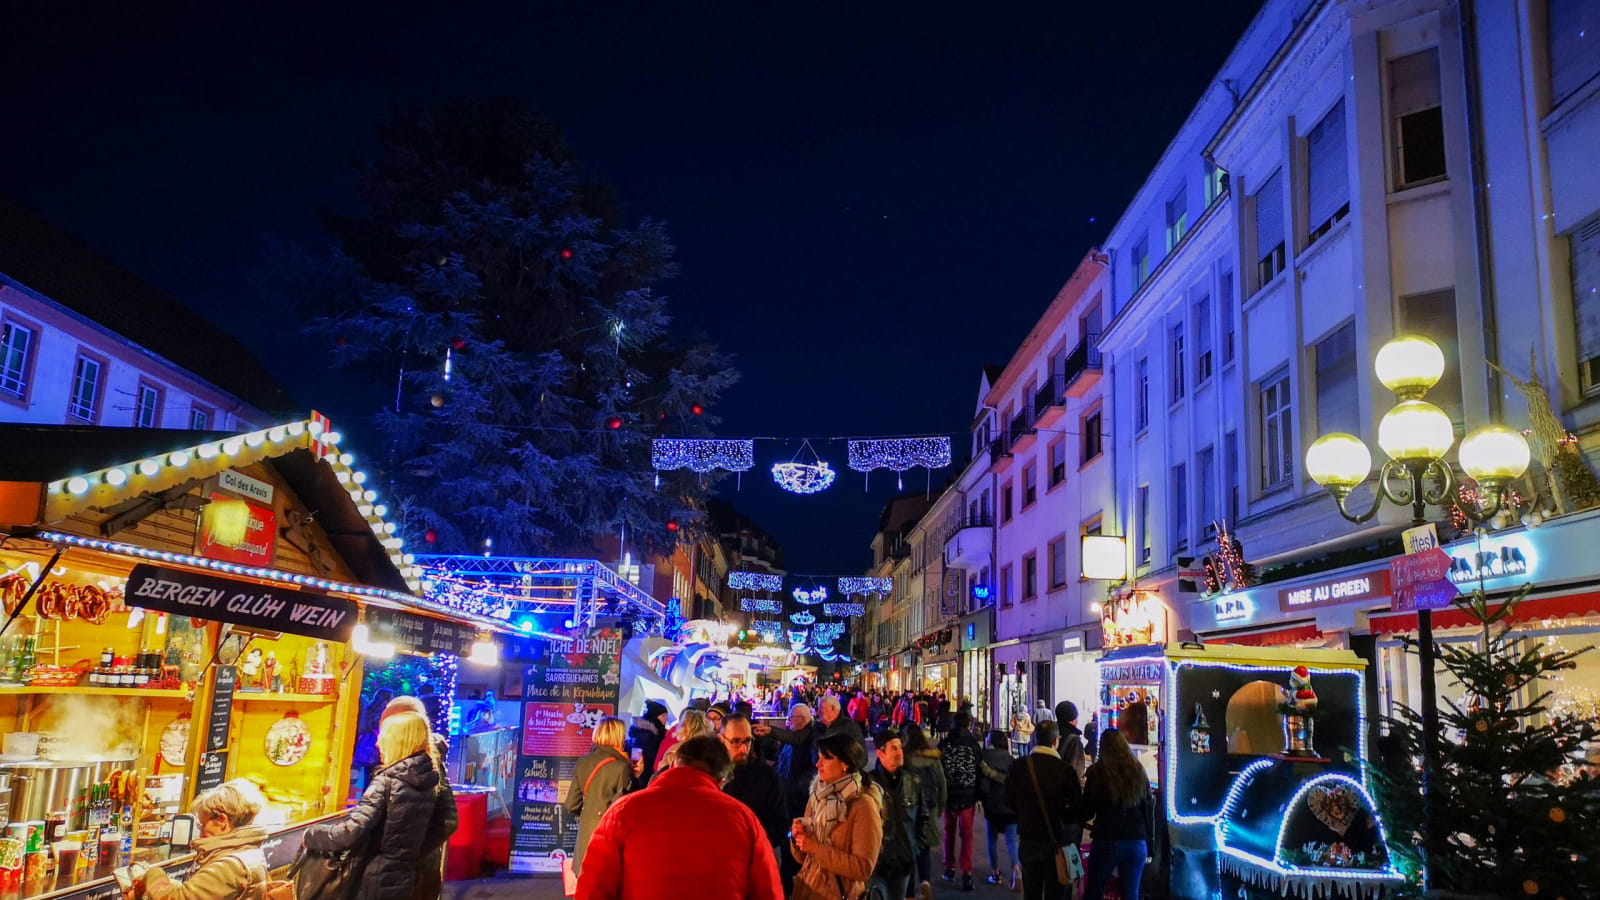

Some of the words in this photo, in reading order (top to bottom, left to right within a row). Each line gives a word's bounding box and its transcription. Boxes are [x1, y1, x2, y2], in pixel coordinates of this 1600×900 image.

[225, 474, 237, 486] Col
[238, 480, 249, 491] des
[249, 484, 268, 498] Aravis
[1288, 588, 1313, 606] MISE
[1314, 585, 1330, 602] AU
[1331, 577, 1370, 599] GREEN
[134, 577, 225, 608] BERGEN
[226, 594, 286, 619] GLÜH
[289, 602, 346, 629] WEIN
[576, 639, 590, 654] DE
[592, 636, 618, 655] NOËL
[545, 673, 599, 683] SARREGUEMINES
[527, 684, 548, 697] Place
[549, 685, 561, 697] de
[573, 685, 615, 703] République
[532, 760, 547, 770] Tout
